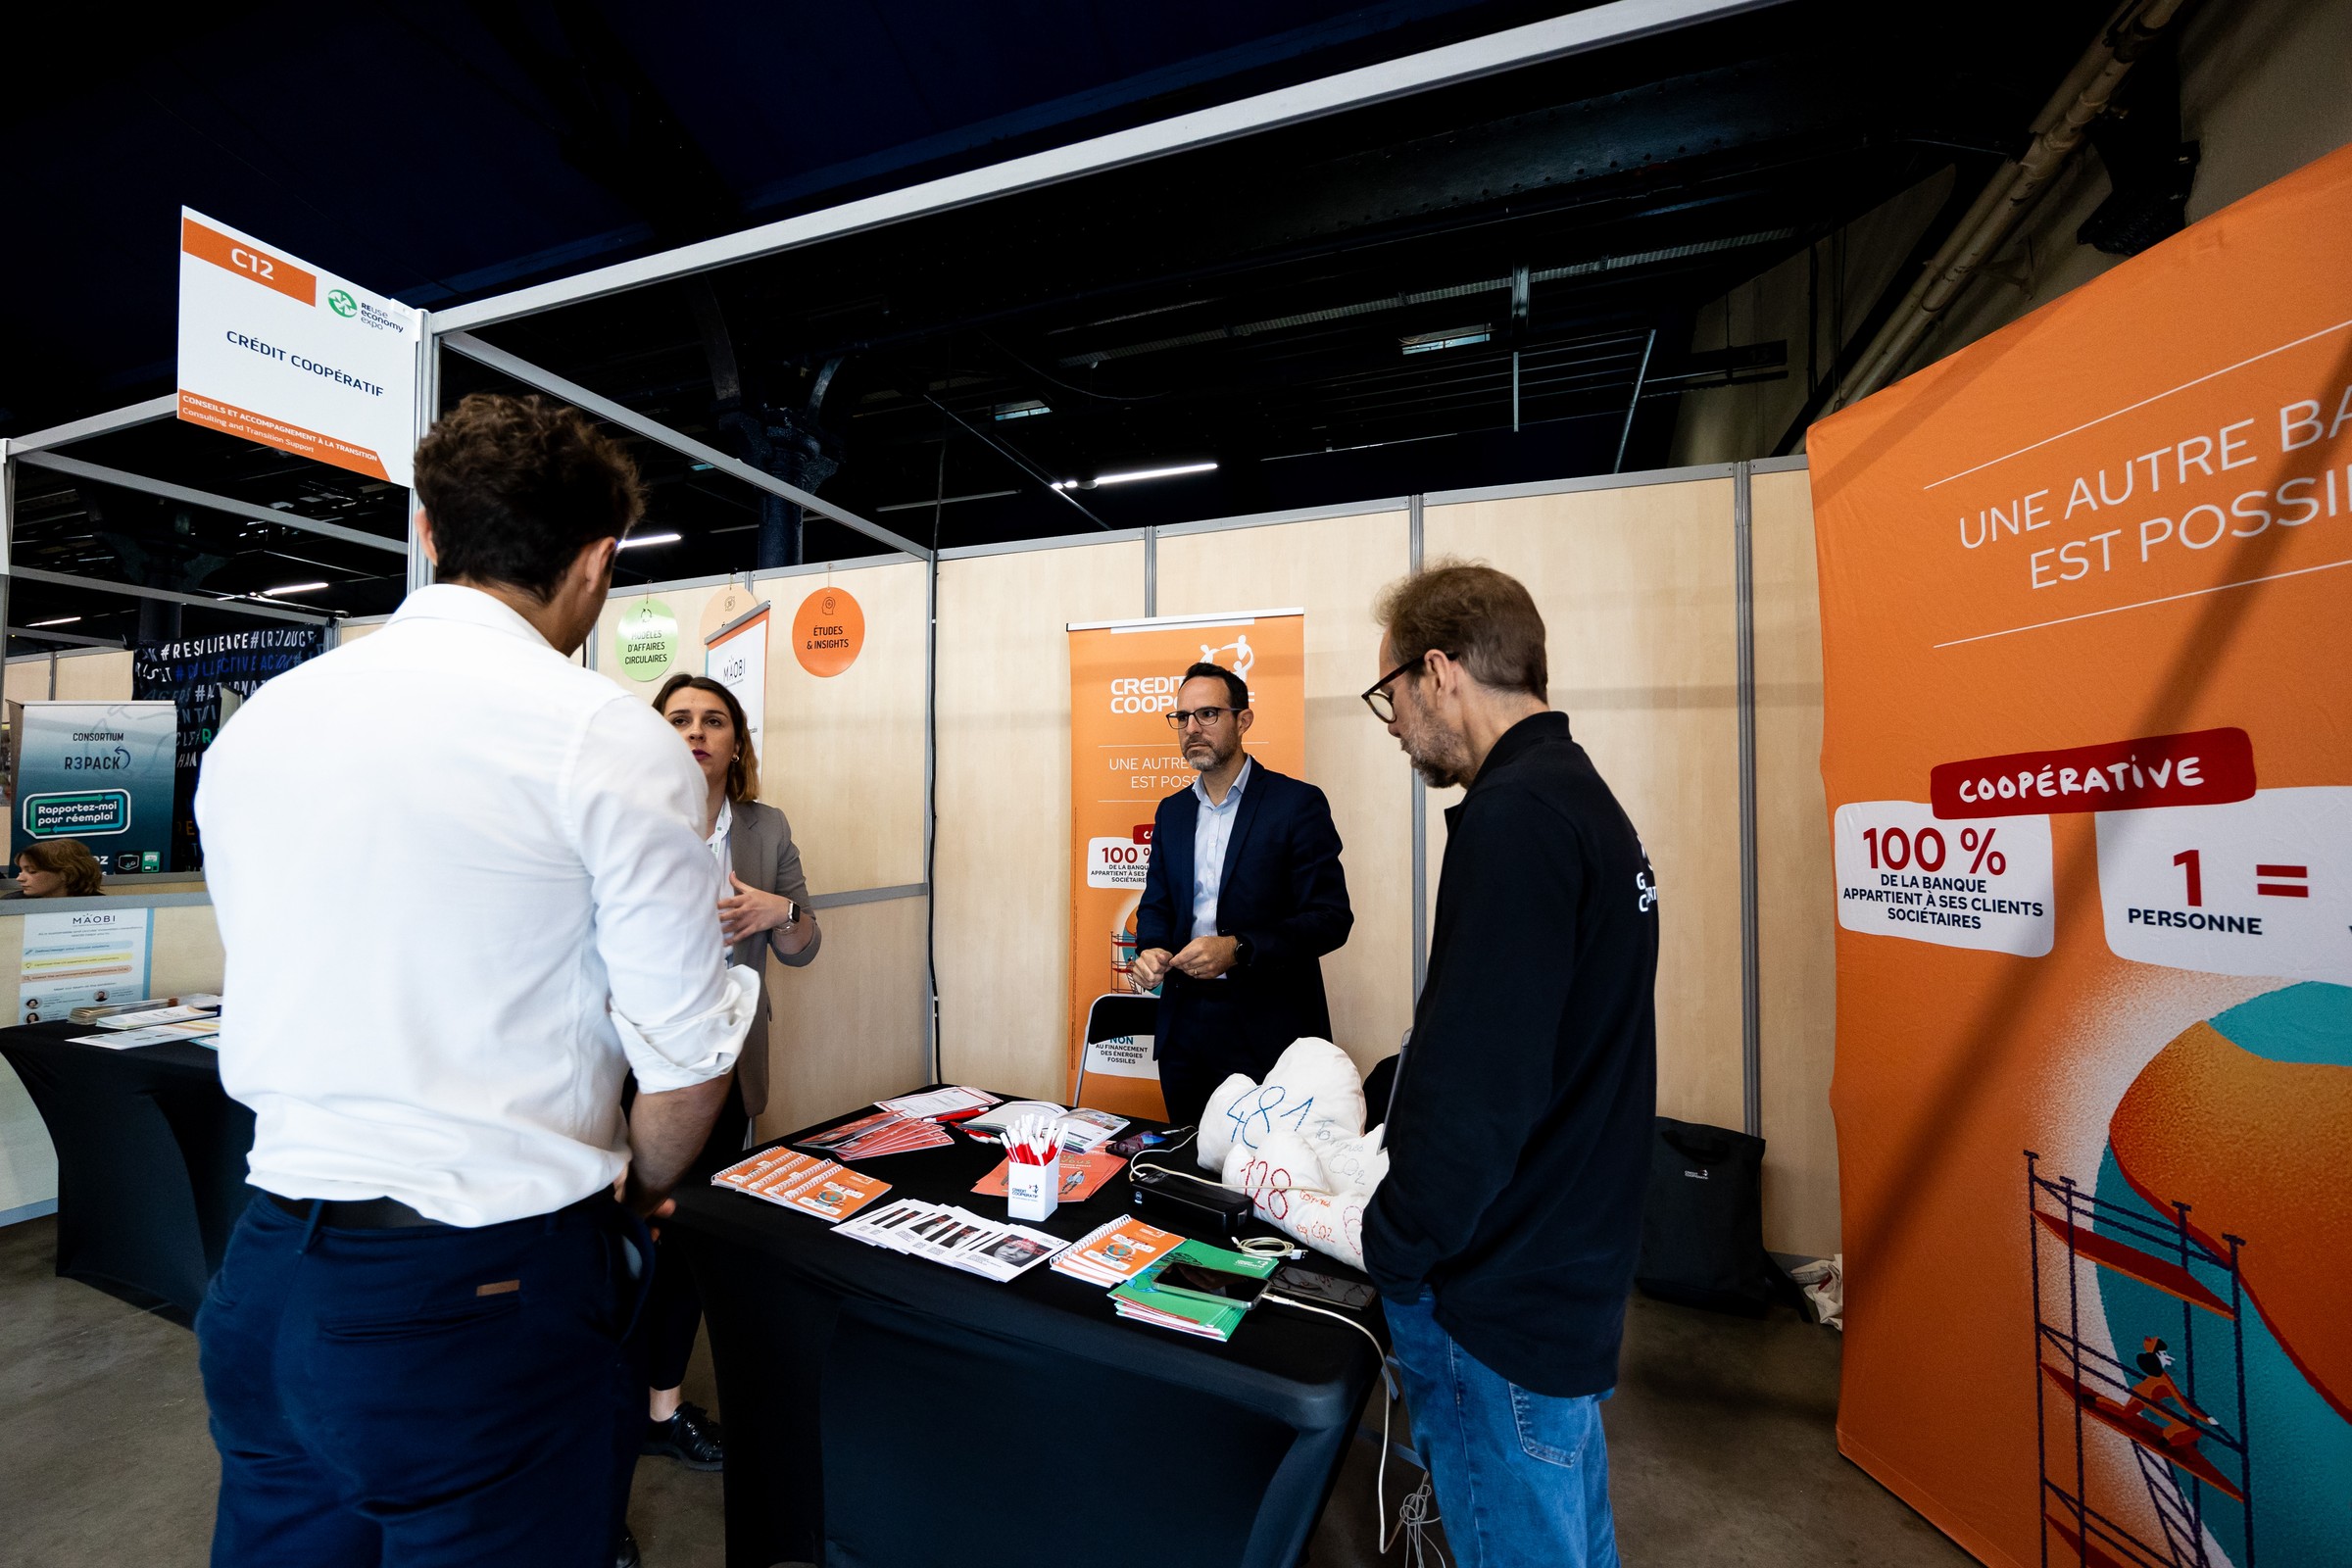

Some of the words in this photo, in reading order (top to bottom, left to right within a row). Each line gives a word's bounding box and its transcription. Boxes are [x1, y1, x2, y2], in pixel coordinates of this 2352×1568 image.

[231, 248, 274, 280] C12
[361, 309, 404, 333] economy
[361, 317, 383, 330] expo
[226, 330, 286, 362] CRÉDIT
[290, 354, 384, 397] COOPÉRATIF
[182, 395, 226, 415] CONSEILS
[227, 409, 238, 417] ET
[239, 413, 317, 442] ACCOMPAGNEMENT
[324, 439, 334, 448] LA
[335, 443, 378, 462] TRANSITION
[182, 407, 227, 427] Consulting
[228, 421, 244, 431] and
[245, 425, 284, 443] Transition
[285, 438, 314, 453] Support
[1960, 489, 2051, 549] UNE
[2064, 418, 2258, 518] AUTRE
[2031, 529, 2122, 589] EST
[2139, 463, 2352, 563] POSSI
[813, 625, 843, 636] ÉTUDES
[627, 642, 665, 653] D'AFFAIRES
[807, 640, 812, 650] &
[814, 639, 849, 649] INSIGHTS
[624, 654, 667, 664] CIRCULAIRES
[73, 732, 123, 741] CONSORTIUM
[64, 756, 122, 770] R3PACK
[1109, 758, 1139, 770] UNE
[1142, 757, 1189, 770] AUTRE
[1131, 775, 1157, 788] EST
[38, 801, 117, 815] Rapportez-moi
[38, 815, 64, 826] pour
[66, 811, 113, 823] réemploi
[1102, 847, 1138, 863] 100
[1863, 826, 1946, 872] 100
[1960, 827, 2006, 875] %
[1881, 874, 1898, 887] DE
[1901, 875, 1919, 888] LA
[1923, 877, 1987, 893] BANQUE
[2173, 849, 2202, 906] 1
[1843, 888, 1923, 906] APPARTIENT
[1926, 890, 1936, 907] À
[1938, 895, 1968, 909] SES
[1971, 898, 2044, 917] CLIENTS
[73, 915, 116, 924] MAOBI
[1887, 906, 1982, 930] SOCIÉTAIRES
[2128, 907, 2263, 936] PERSONNE
